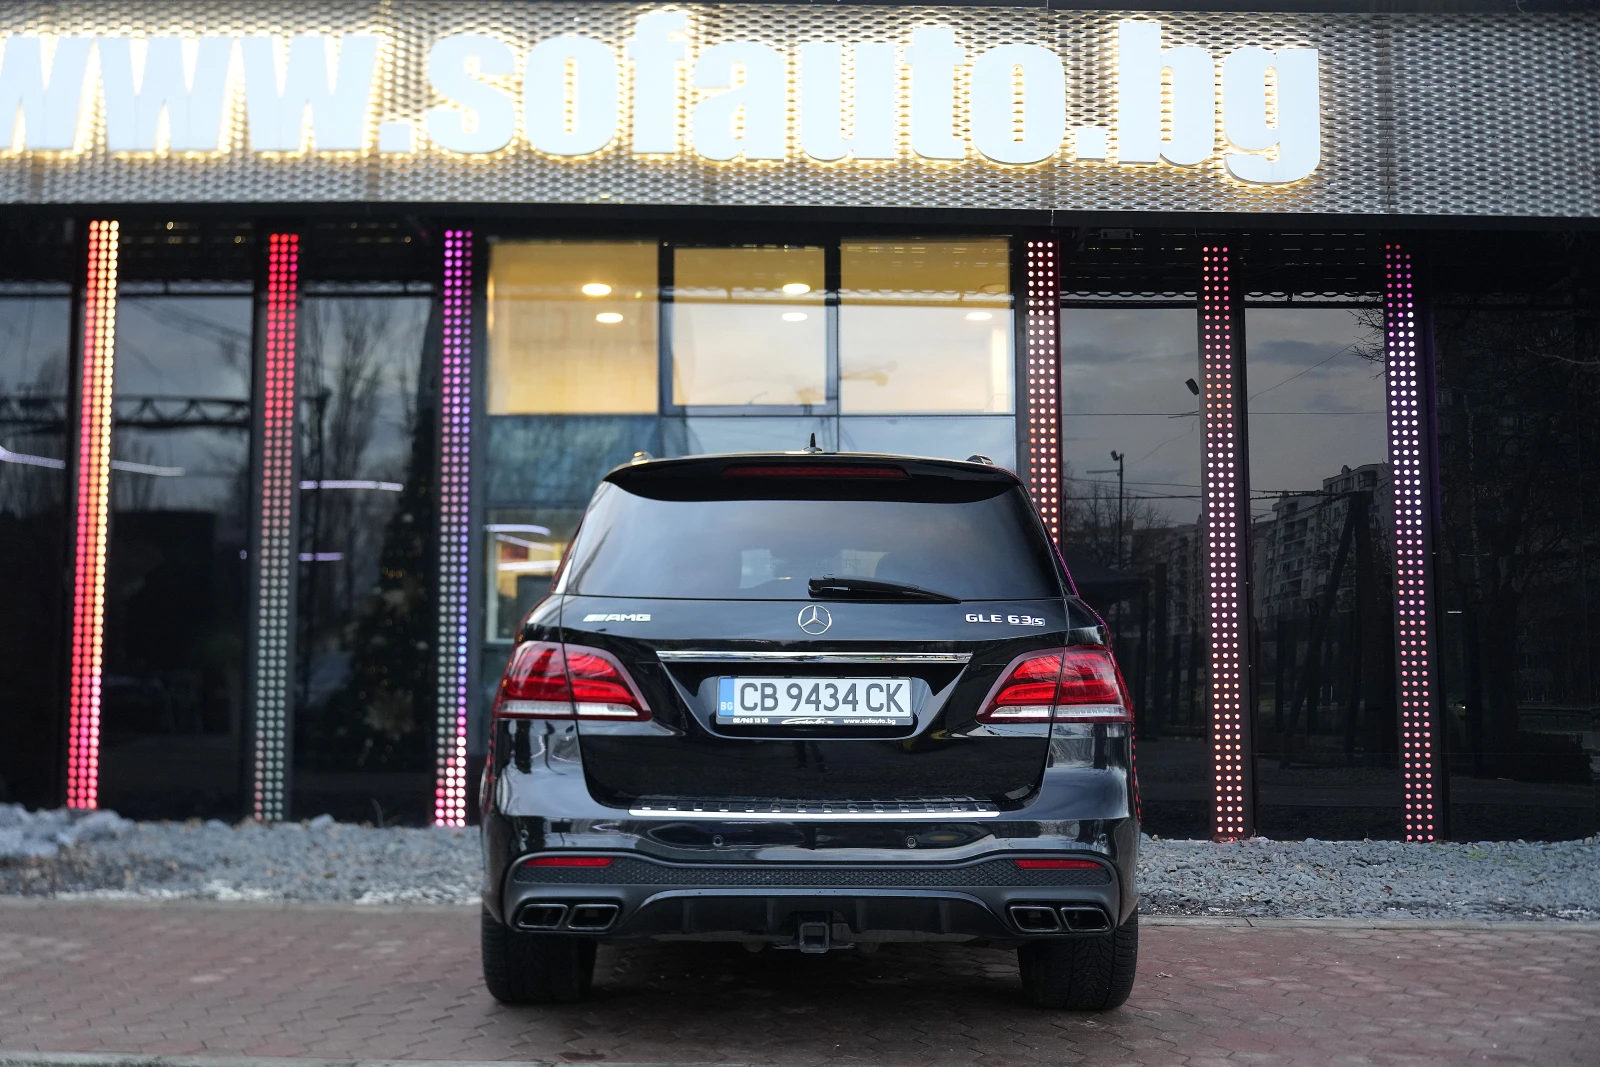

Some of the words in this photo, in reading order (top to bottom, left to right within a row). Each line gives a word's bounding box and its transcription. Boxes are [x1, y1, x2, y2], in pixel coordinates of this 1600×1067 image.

[0, 11, 1320, 184] www.sofauto.bg
[604, 613, 652, 622] AMG
[965, 613, 1003, 623] GLE
[739, 682, 779, 712] CB
[786, 683, 859, 712] 9434
[865, 683, 904, 713] CK
[720, 701, 734, 711] BG
